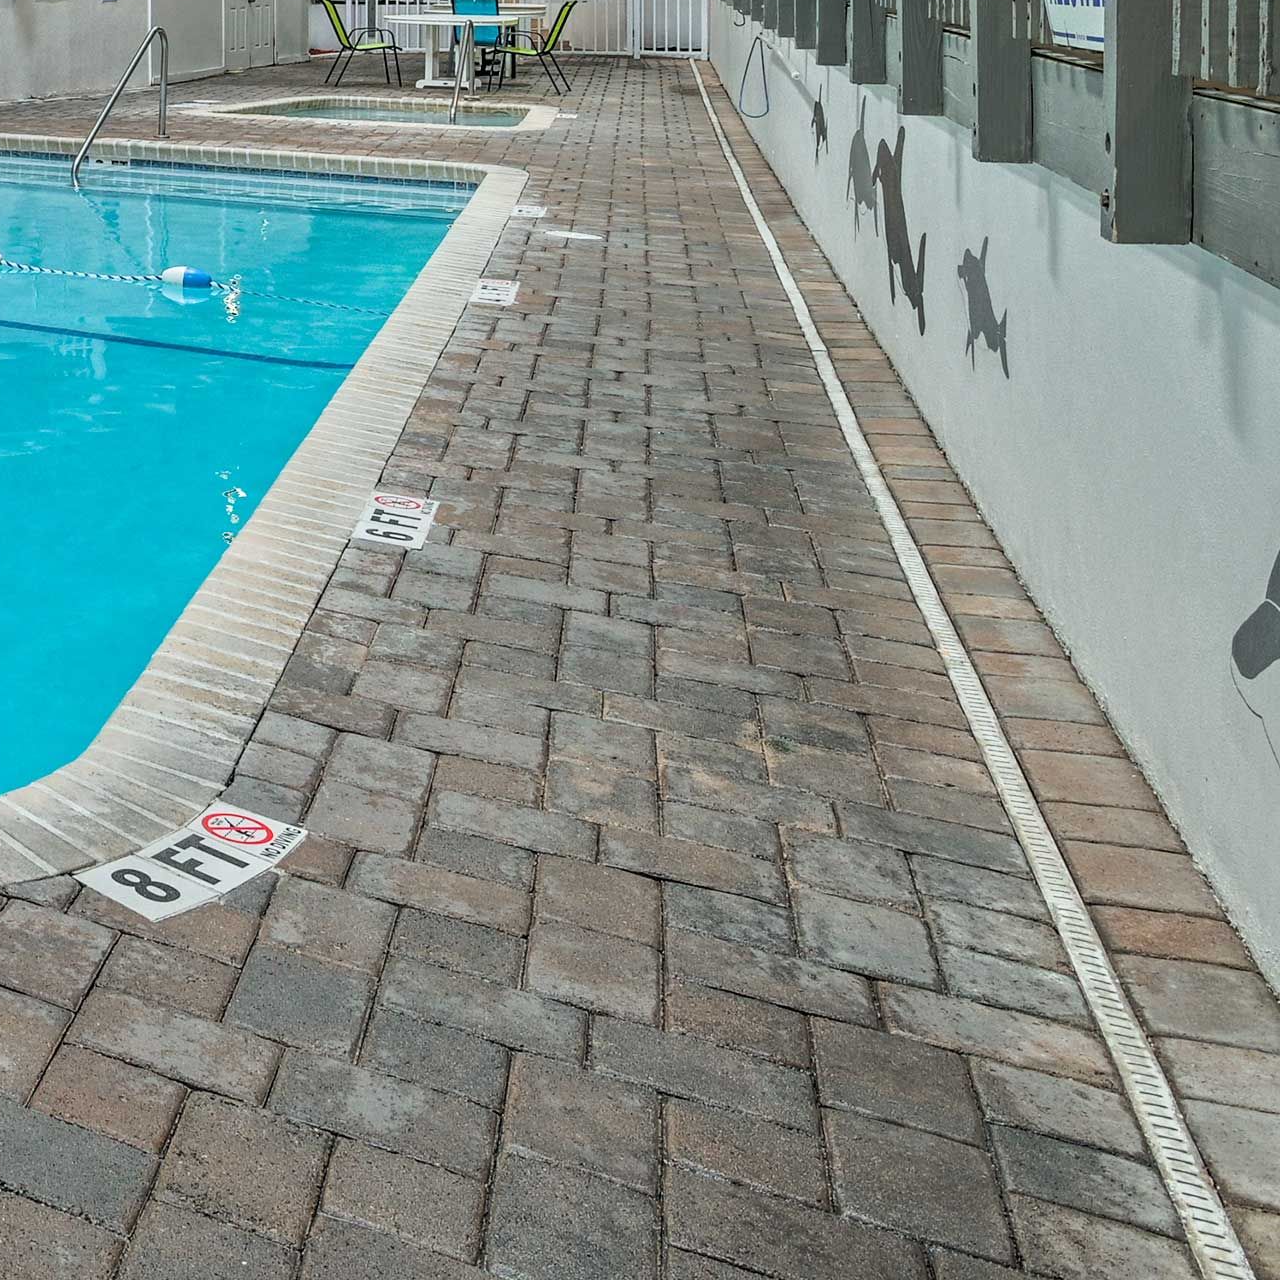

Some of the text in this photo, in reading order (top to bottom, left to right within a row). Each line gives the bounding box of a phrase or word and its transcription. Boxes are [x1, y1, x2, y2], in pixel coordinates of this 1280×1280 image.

[365, 508, 422, 542] 6 FT
[260, 827, 302, 860] NO DIVING
[111, 833, 250, 903] 8 FT
